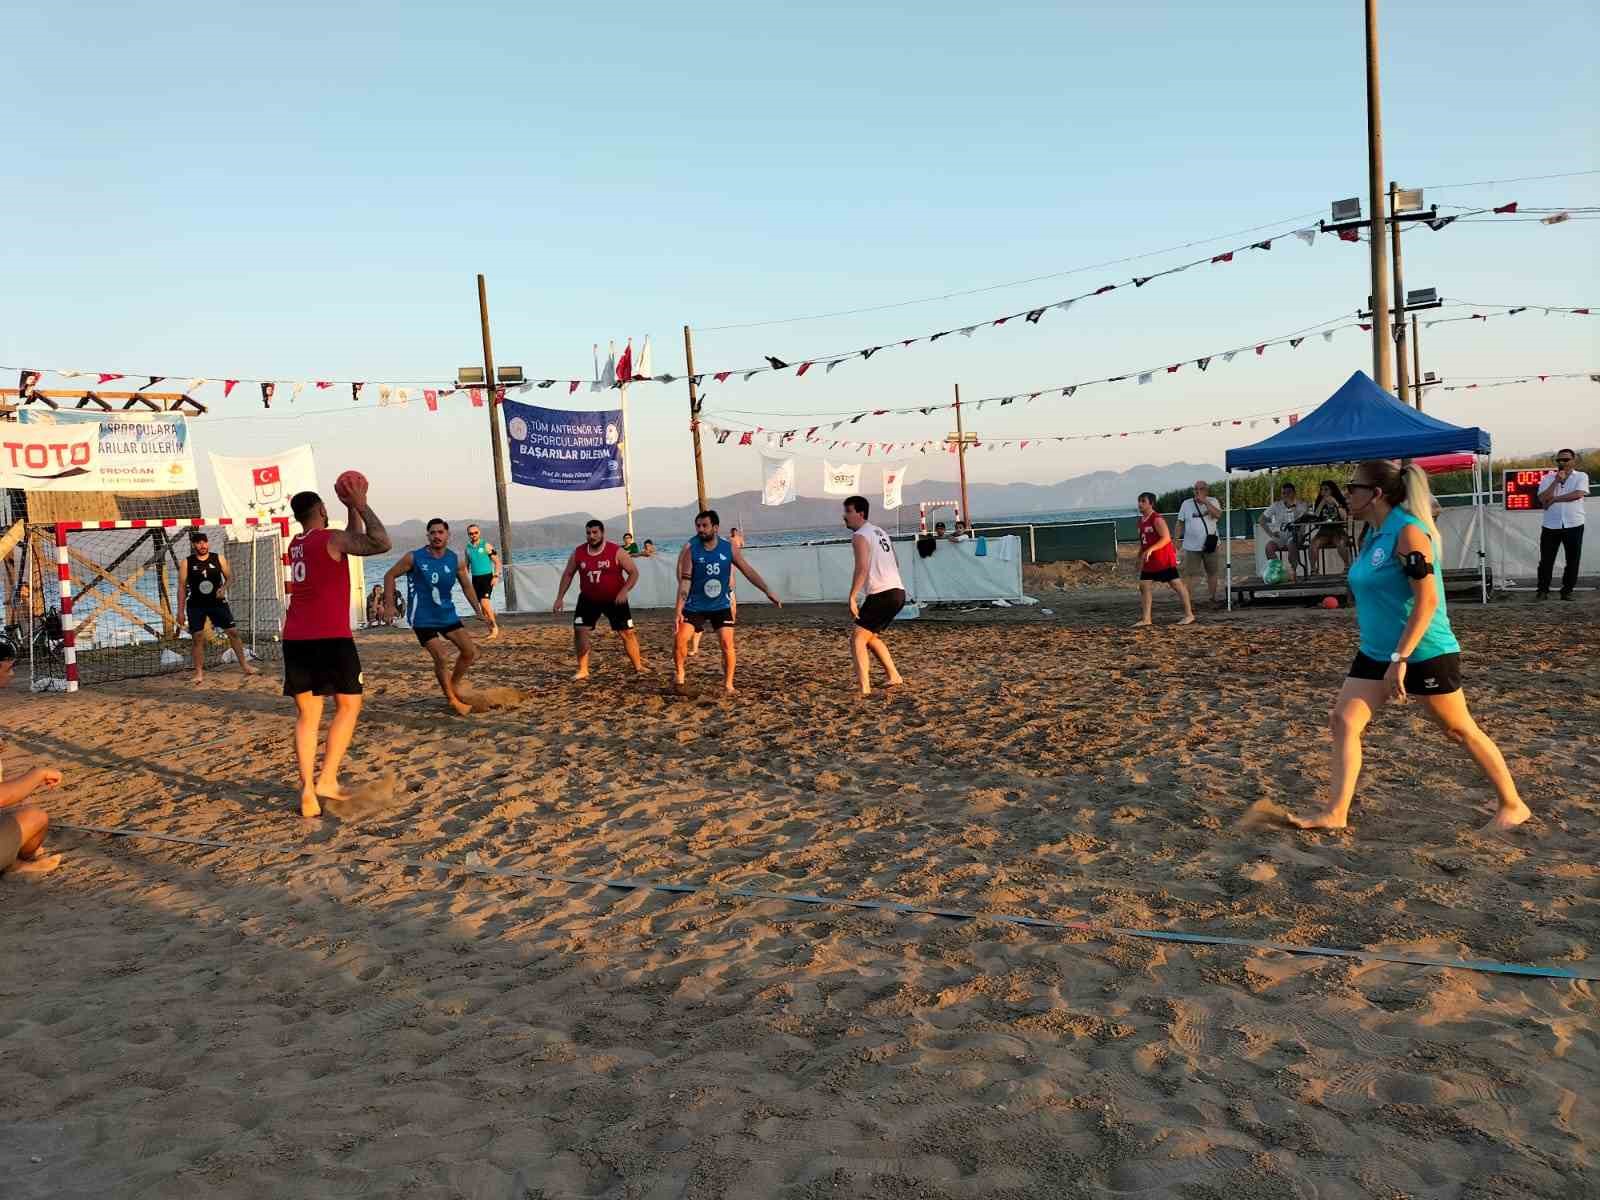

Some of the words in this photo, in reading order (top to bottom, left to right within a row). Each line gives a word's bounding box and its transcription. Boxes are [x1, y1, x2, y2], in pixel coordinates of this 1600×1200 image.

[531, 421, 549, 433] TÜM
[550, 424, 593, 435] ANTRENÖR
[594, 425, 603, 434] VE
[530, 433, 604, 447] SPORCULARIMIZA
[3, 442, 91, 469] TOTO
[519, 444, 578, 459] BAŞARILAR
[580, 448, 611, 460] DİLERİM
[431, 572, 439, 584] 9
[587, 571, 601, 583] 17
